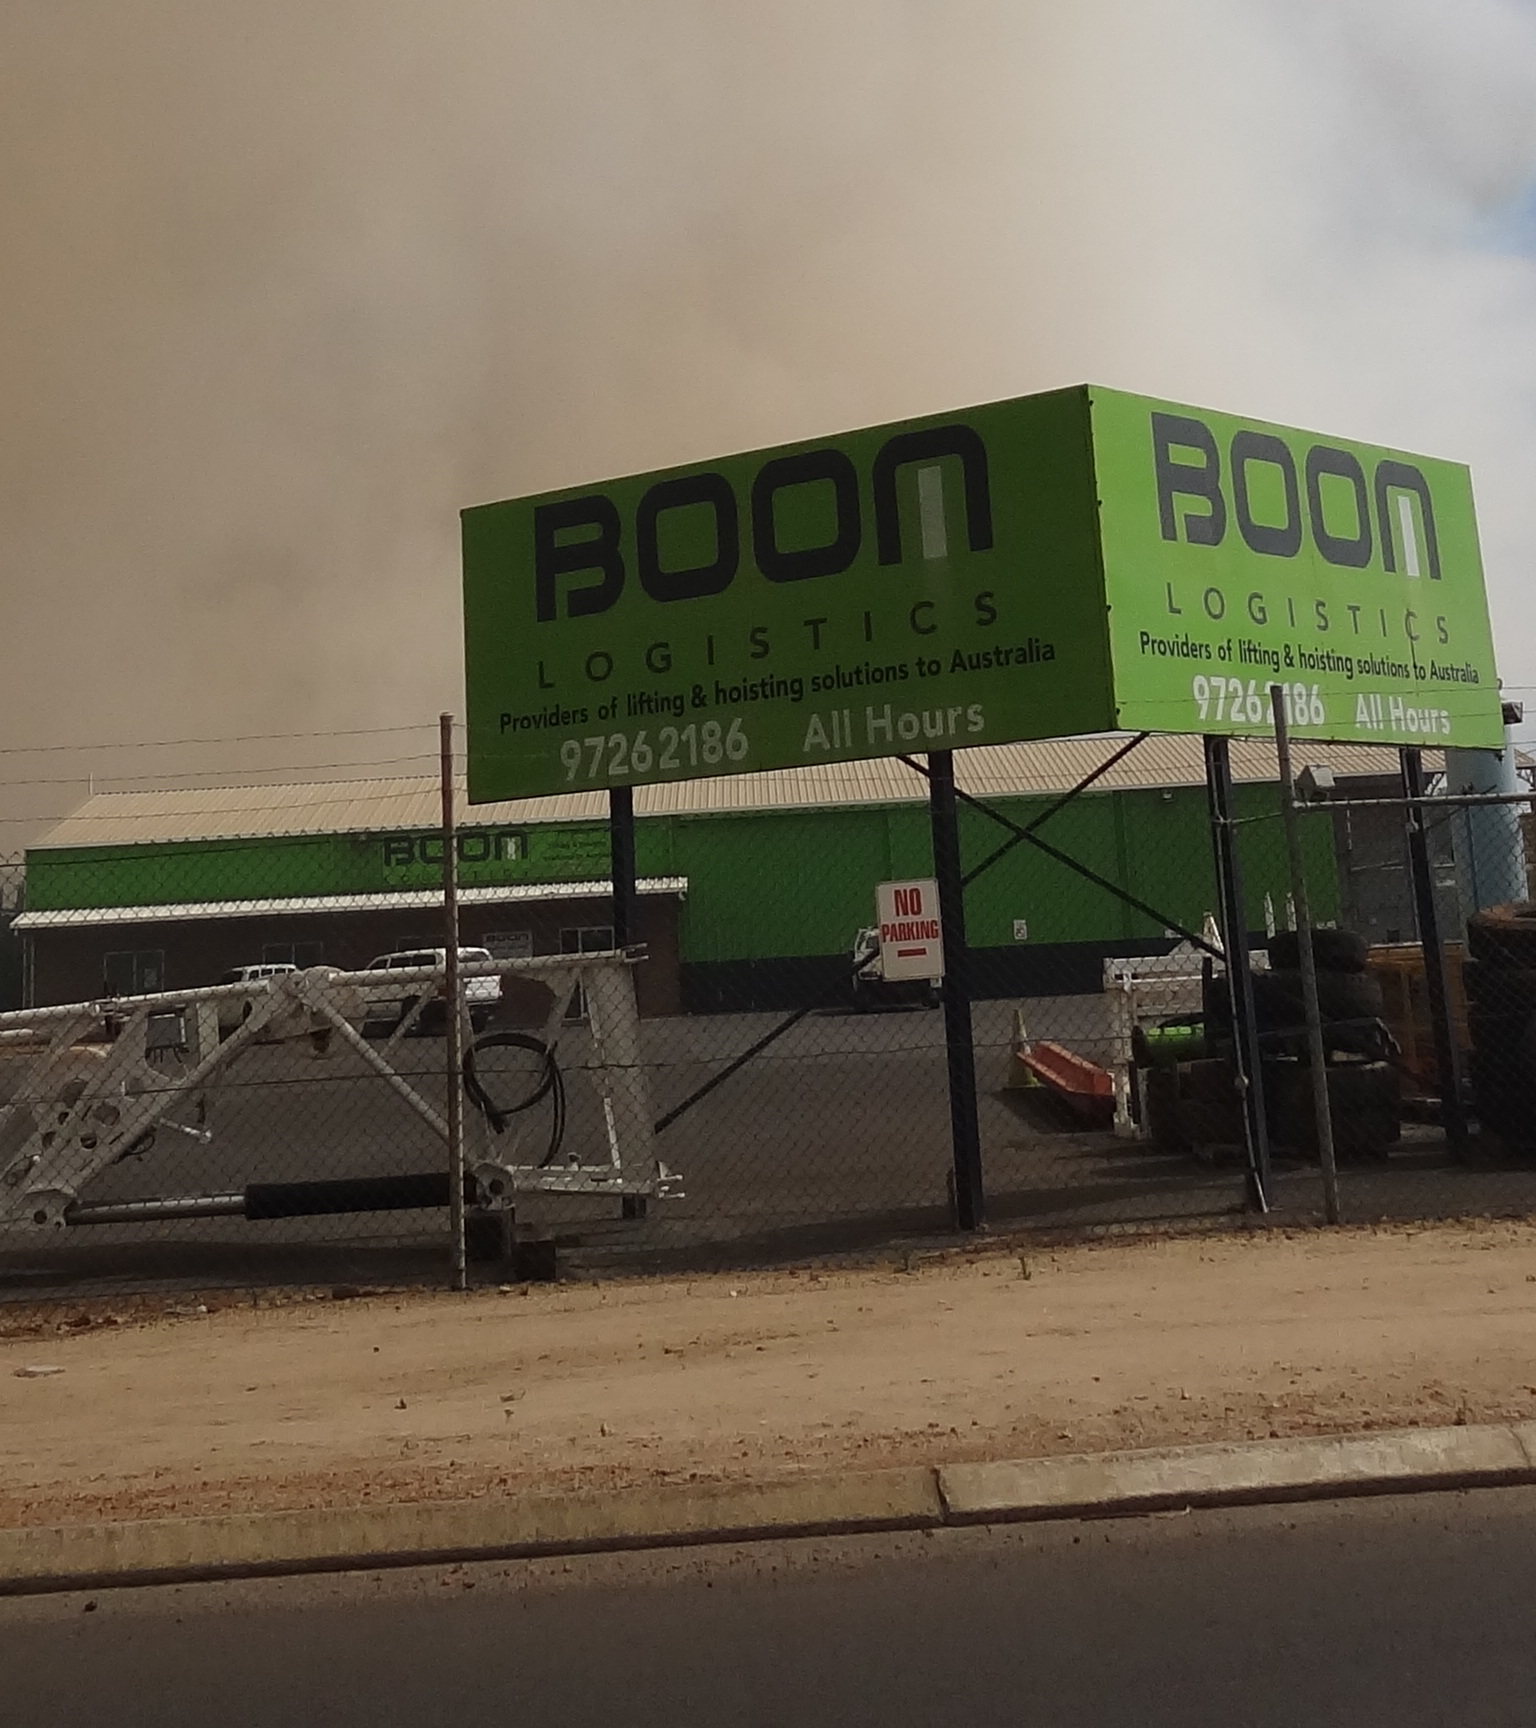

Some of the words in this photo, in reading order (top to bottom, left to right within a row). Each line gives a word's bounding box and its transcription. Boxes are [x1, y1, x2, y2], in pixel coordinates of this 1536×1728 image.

[1151, 412, 1441, 580] BOOM
[534, 424, 993, 622] BOOM
[1167, 582, 1448, 644] LOGISTICS
[538, 591, 997, 689] LOGISTICS
[1140, 631, 1212, 660] Providers
[1218, 638, 1232, 662] of
[1239, 639, 1280, 672] lifting
[1284, 643, 1295, 668] &
[1298, 644, 1353, 679] hoisting
[1357, 653, 1410, 679] solutions
[1413, 661, 1426, 680] to
[1429, 659, 1480, 684] Australia
[500, 704, 588, 733] Providers
[598, 696, 617, 720] of
[627, 691, 684, 717] lifting
[691, 684, 707, 708] &
[714, 674, 804, 702] hoisting
[811, 662, 908, 692] solutions
[916, 657, 941, 677] to
[950, 638, 1055, 673] Australia
[803, 709, 852, 752] All
[866, 704, 985, 744] Hours
[1355, 693, 1384, 730] All
[1389, 696, 1451, 735] Hours
[384, 829, 528, 866] BOOM
[894, 888, 922, 917] NO
[882, 920, 939, 942] PARKING
